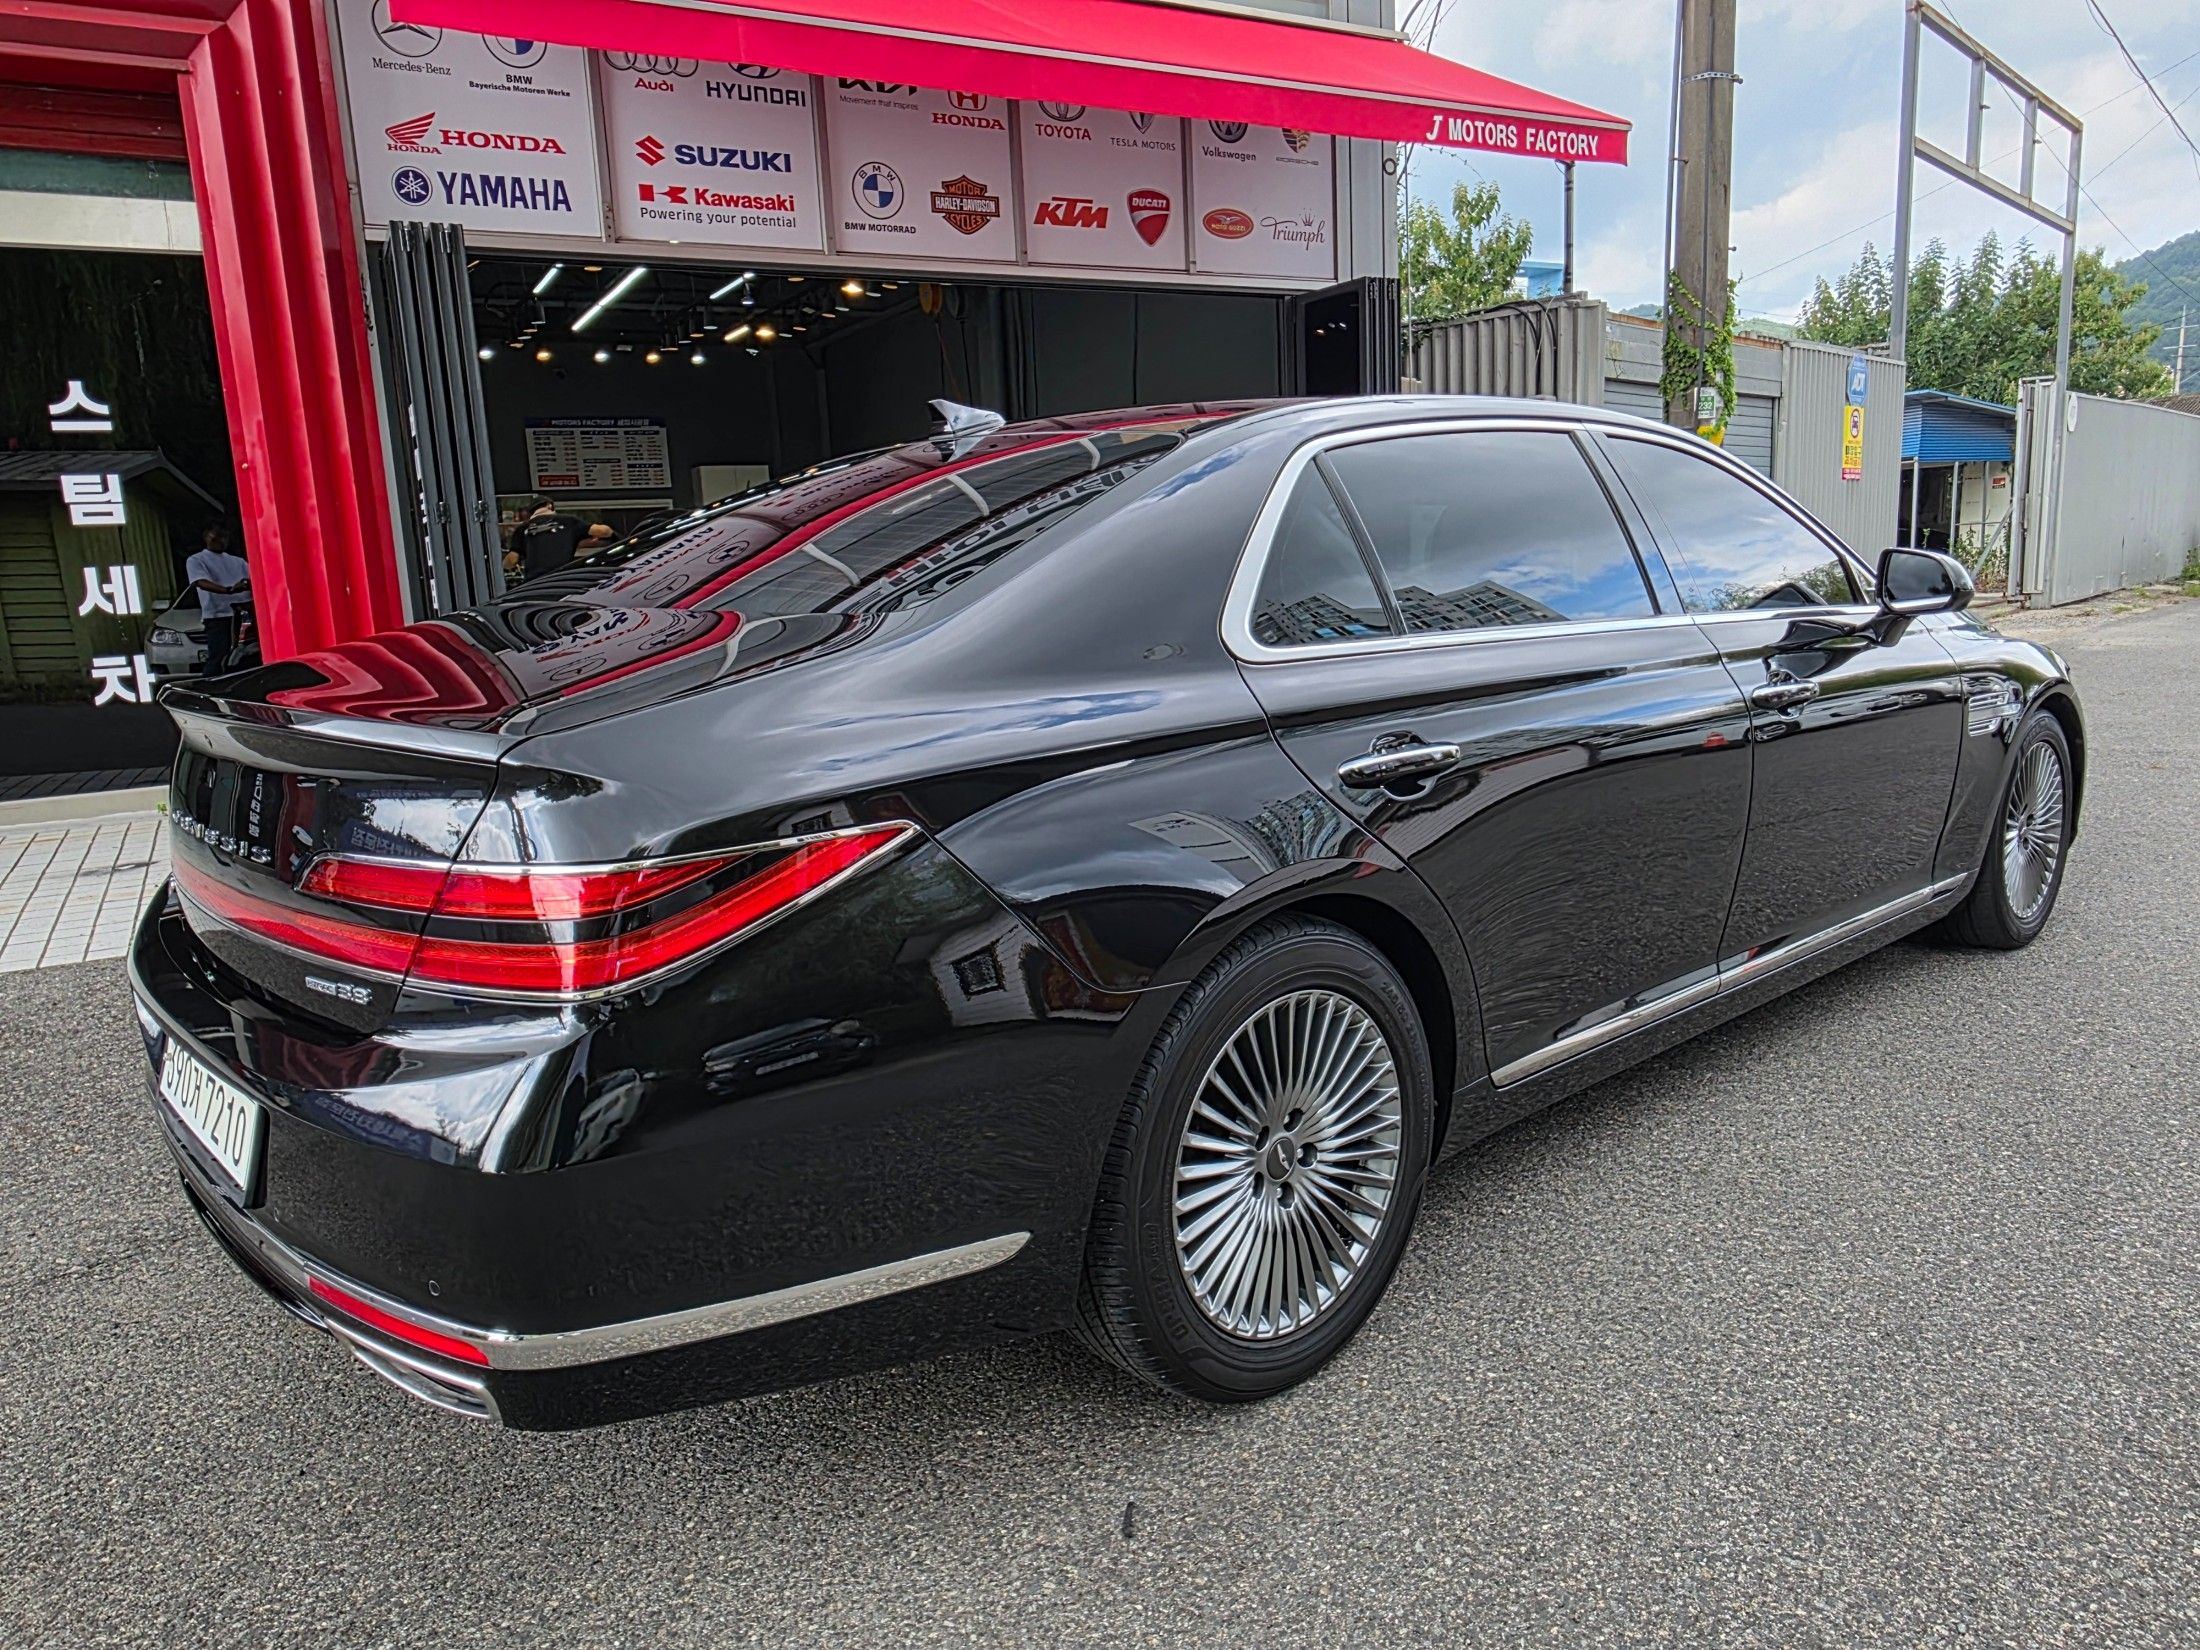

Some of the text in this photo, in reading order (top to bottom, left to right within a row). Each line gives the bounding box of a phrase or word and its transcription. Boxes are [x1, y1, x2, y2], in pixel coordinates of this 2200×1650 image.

[372, 57, 452, 76] Mercedes-Benz
[469, 80, 570, 97] Bayerische Motoren Werke
[505, 74, 533, 85] BMW
[634, 77, 674, 92] Audi
[706, 80, 806, 107] HYUNDAI
[839, 95, 876, 106] Movement
[878, 99, 892, 108] that
[932, 112, 1006, 131] HONDA
[1035, 123, 1092, 141] TOYOTA
[1425, 115, 1599, 156] J MOTORS FACTORY
[387, 143, 442, 155] HONDA
[438, 129, 566, 154] HONDA
[1110, 137, 1176, 151] TESLA MOTORS
[674, 144, 792, 173] SUZUKI
[1202, 146, 1256, 162] Volkswagen
[858, 164, 896, 182] BMW
[436, 171, 572, 212] YAMAHA
[948, 181, 981, 196] MOTOR
[694, 188, 795, 212] Kawasaki
[935, 196, 995, 213] HARLEY-DAVIDSON
[1132, 197, 1167, 208] DUCATI
[640, 207, 796, 228] Powering your potential
[951, 213, 983, 230] CYCLES
[1033, 196, 1109, 229] KTM
[844, 222, 916, 234] BMW MOTORRAD
[1260, 216, 1326, 251] Triumph
[48, 380, 156, 706] 스팀세차
